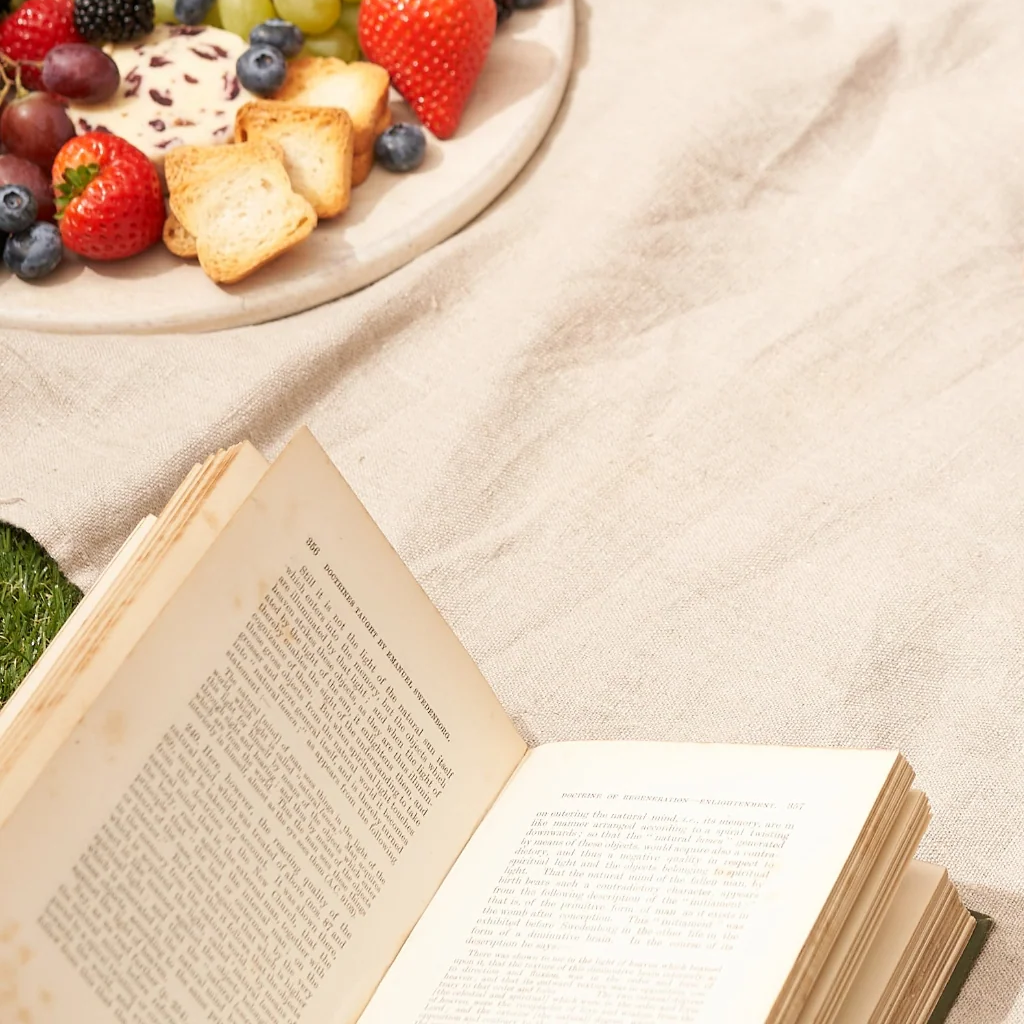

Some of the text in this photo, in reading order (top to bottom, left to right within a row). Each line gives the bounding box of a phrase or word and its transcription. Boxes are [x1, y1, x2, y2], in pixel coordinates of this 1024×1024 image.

[231, 636, 251, 661] into
[305, 736, 316, 752] as
[311, 747, 342, 789] appears
[339, 780, 359, 807] from
[356, 803, 372, 825] the
[366, 819, 401, 868] following
[235, 628, 405, 855] grosser and more general itself, and is thereby turned
[244, 617, 412, 846] these gross objects from the natural world it becomes
[248, 608, 417, 837] cognizance of them. But when spiritual light touches
[254, 599, 424, 827] thereby enables the sight of the understanding to take
[263, 590, 429, 817] ated by the light of the sun, it enlightens them, and
[270, 581, 297, 618] heaven
[293, 612, 320, 648] strikes
[315, 642, 337, 672] these
[330, 666, 361, 708] objects,
[357, 702, 368, 717] as
[364, 712, 385, 741] they
[380, 735, 394, 753] are
[392, 748, 411, 774] thus
[277, 574, 291, 593] are
[289, 588, 329, 643] illuminated
[323, 638, 339, 659] by
[335, 651, 353, 676] that
[372, 702, 389, 725] and
[385, 720, 406, 749] when
[404, 746, 419, 767] the
[413, 761, 435, 792] light
[431, 782, 443, 800] of
[284, 563, 449, 790] which enters into the memory, but the objects which
[297, 563, 455, 781] Still it is not the light of the natural sun itself
[304, 534, 453, 743] 356 DOCTRINES TAUGHT BY EMANUEL SWEDENBORG.
